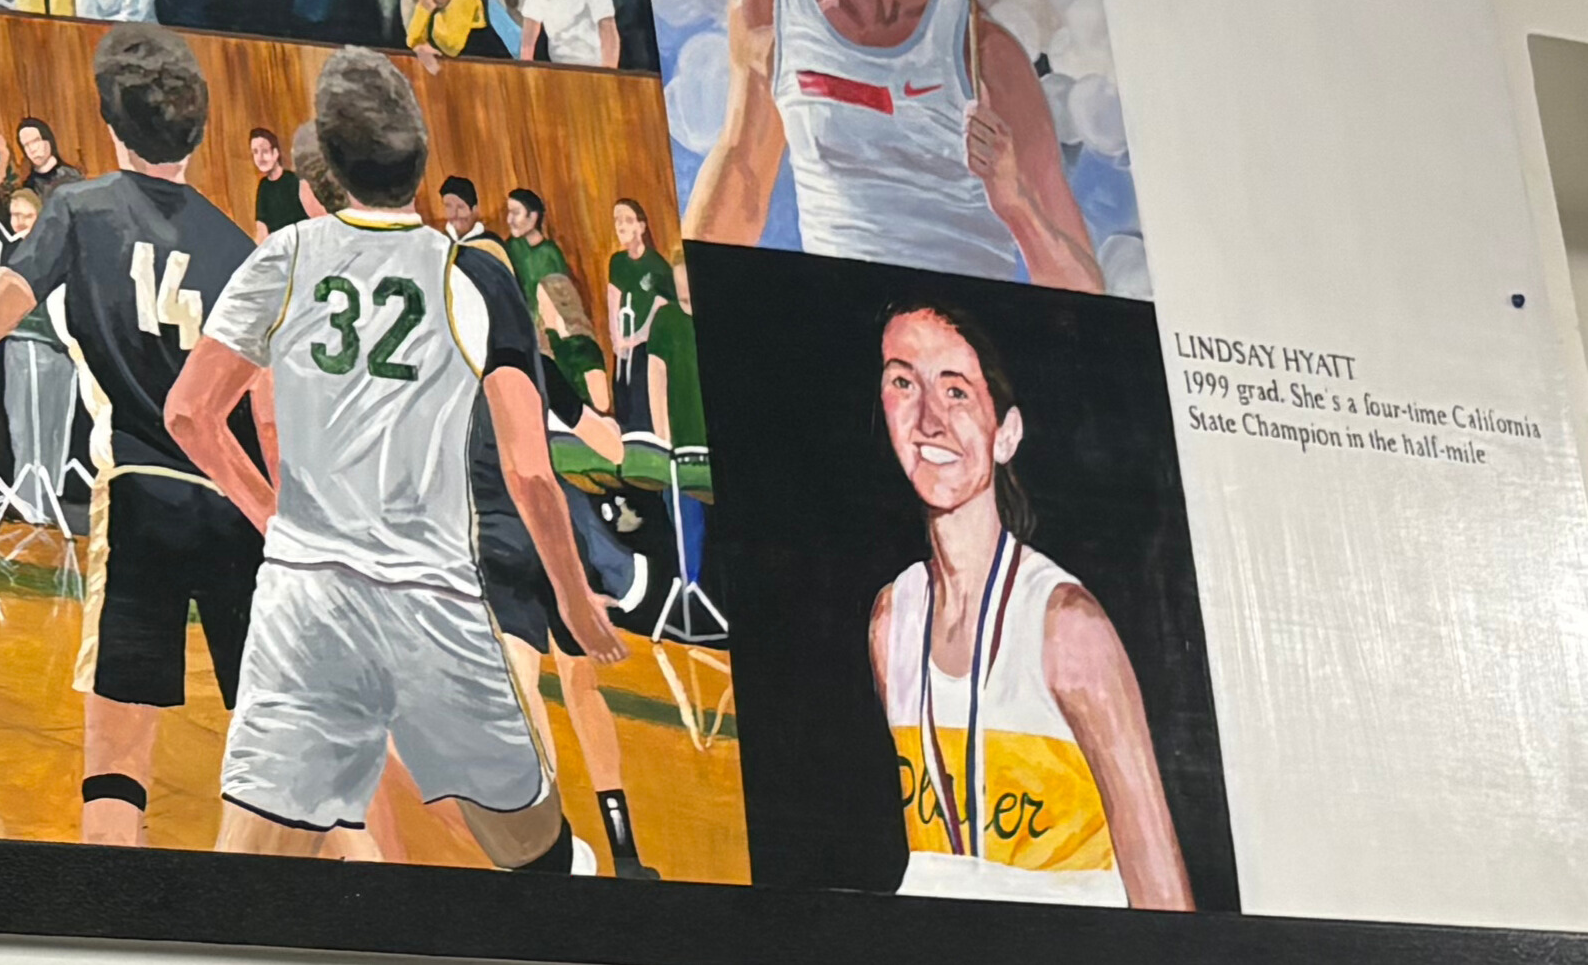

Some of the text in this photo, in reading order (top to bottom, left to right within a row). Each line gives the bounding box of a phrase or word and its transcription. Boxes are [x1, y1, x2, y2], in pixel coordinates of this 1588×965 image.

[129, 241, 203, 350] 14
[309, 274, 426, 381] 32
[1175, 333, 1356, 380] LINDSAY HYATT
[1183, 370, 1541, 439] 1999 grad. She's a four-time California
[1188, 406, 1486, 464] State Champion in the half-mile
